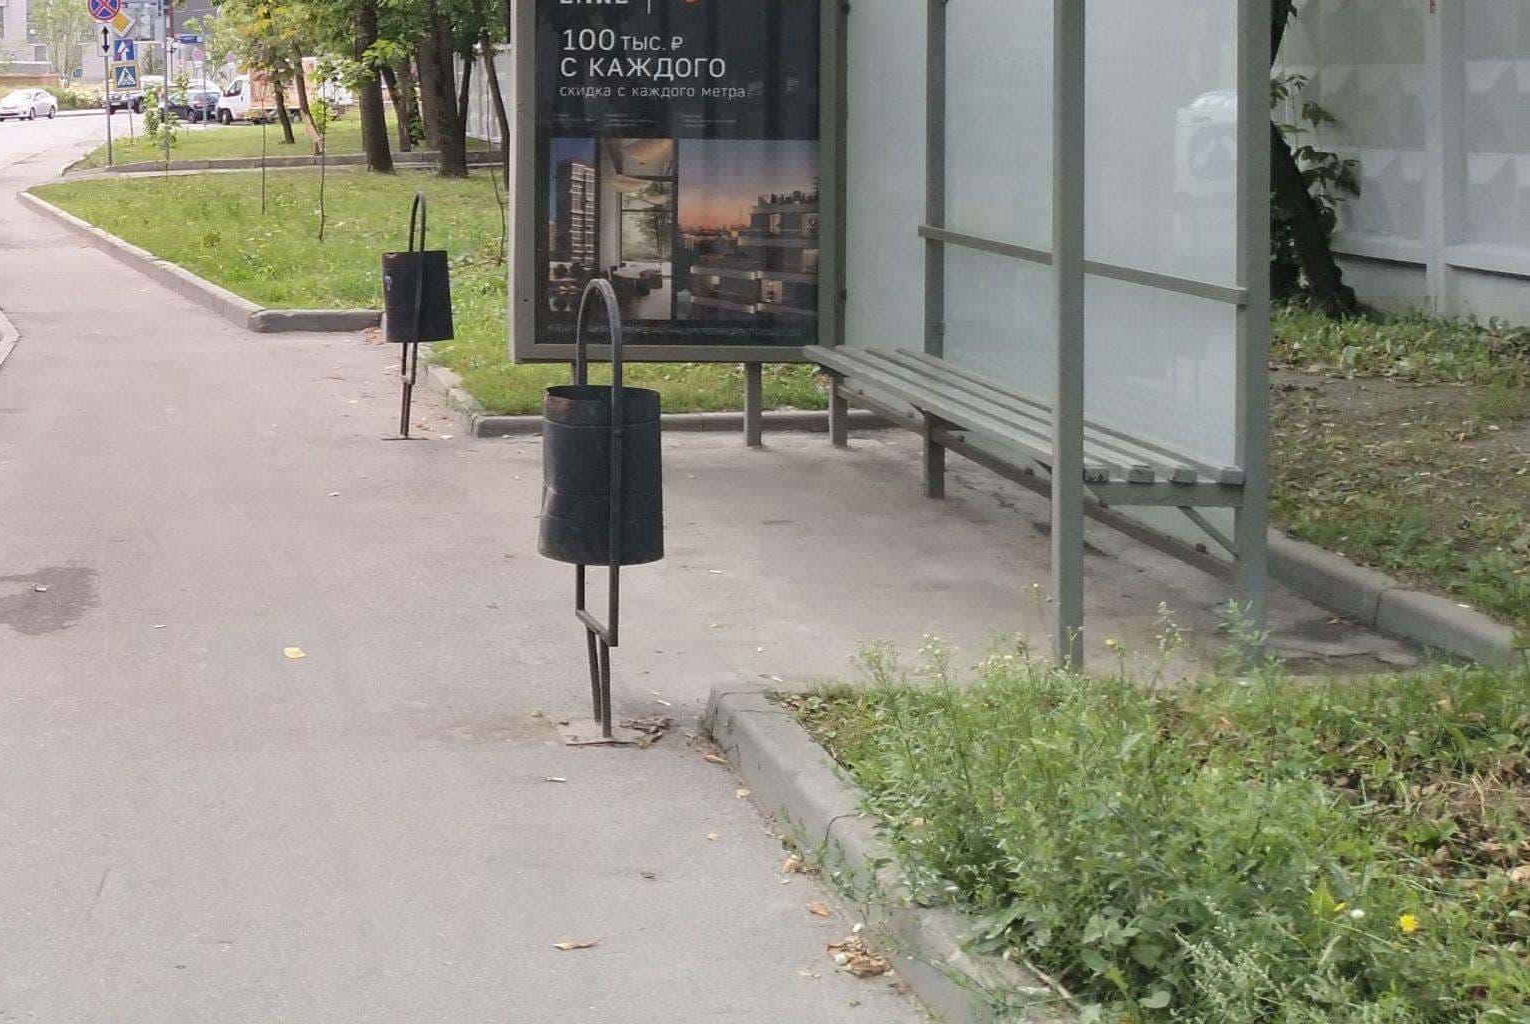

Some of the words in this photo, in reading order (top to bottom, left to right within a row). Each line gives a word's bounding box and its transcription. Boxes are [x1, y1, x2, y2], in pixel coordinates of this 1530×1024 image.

[563, 28, 616, 51] 100
[560, 57, 577, 77] С
[589, 57, 726, 82] КАЖДОГО
[559, 86, 611, 99] скидка
[617, 86, 626, 97] с
[632, 86, 695, 99] каждого
[701, 86, 746, 101] метра
